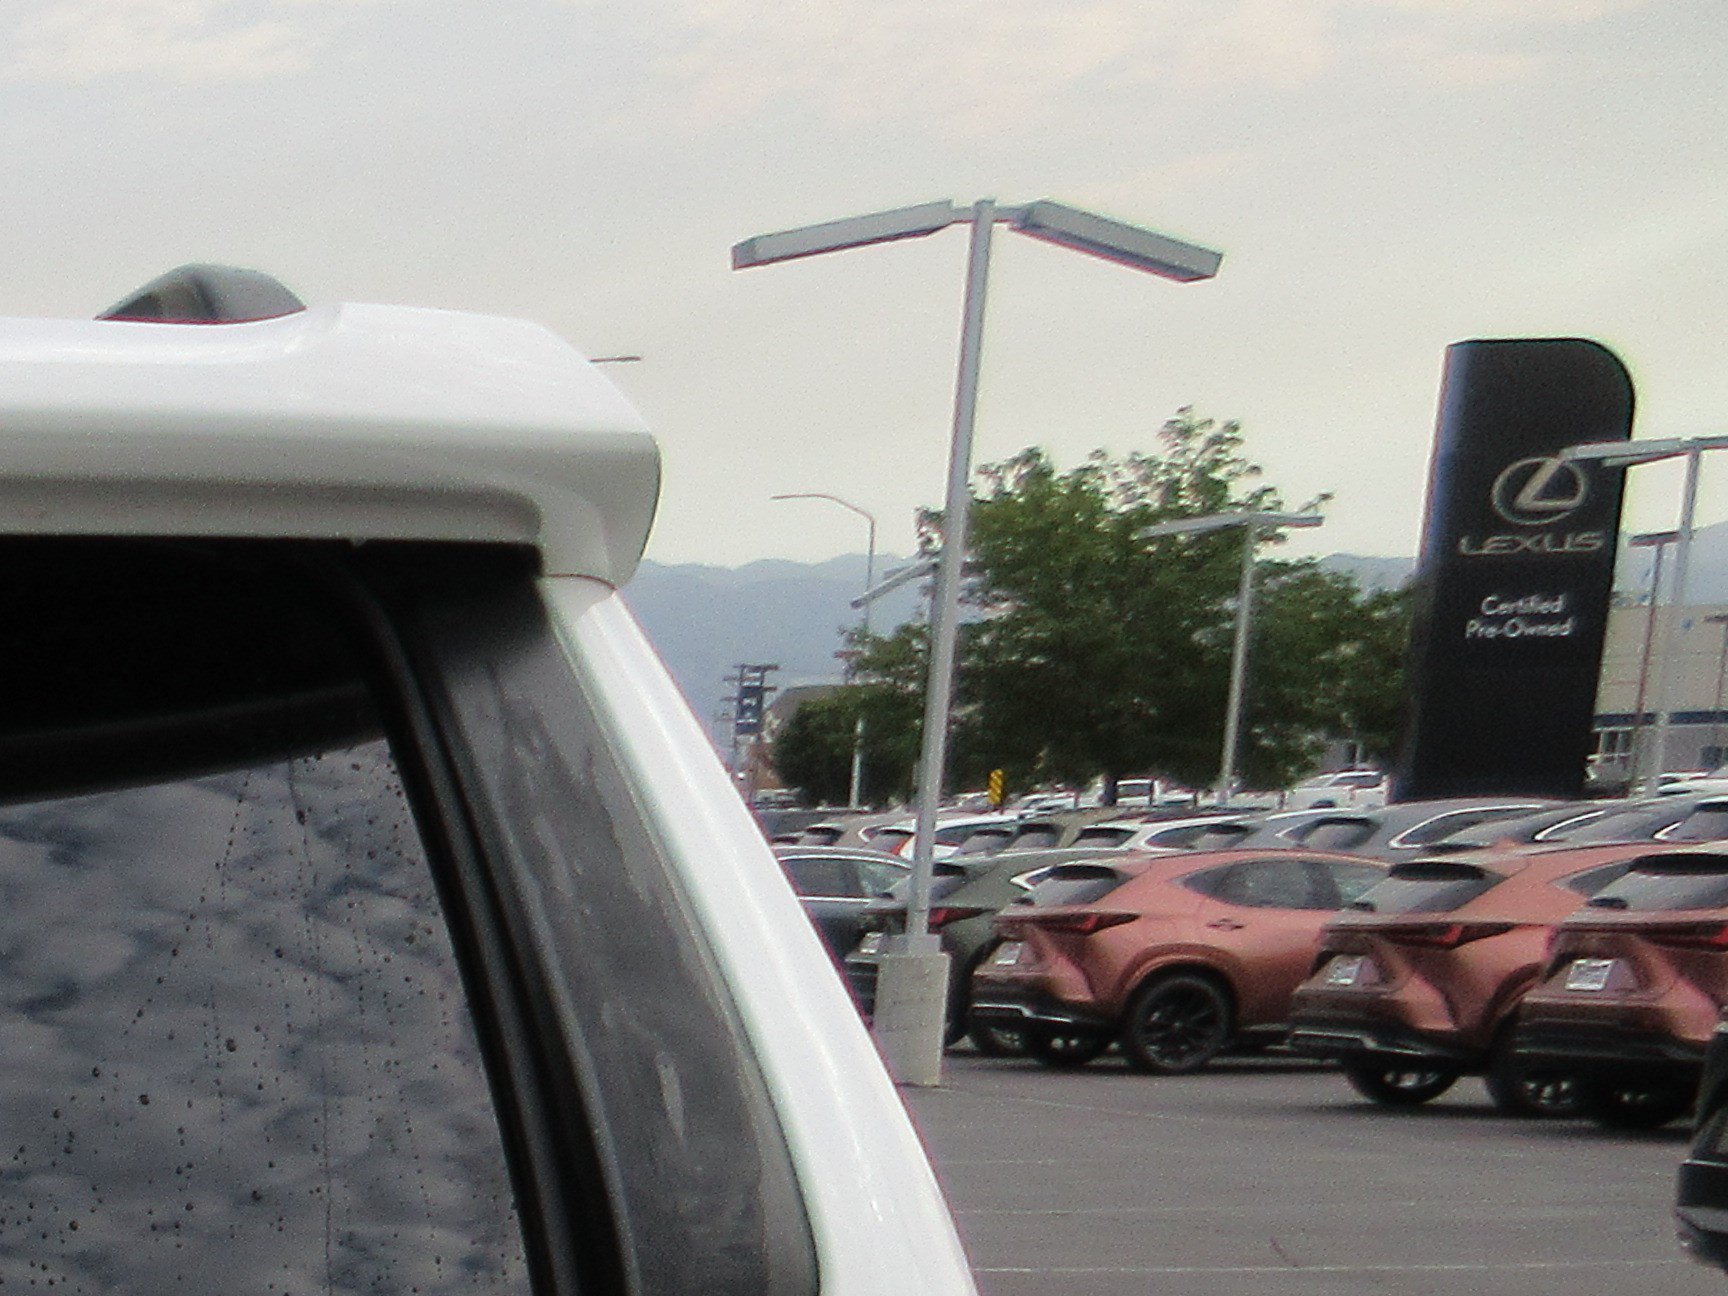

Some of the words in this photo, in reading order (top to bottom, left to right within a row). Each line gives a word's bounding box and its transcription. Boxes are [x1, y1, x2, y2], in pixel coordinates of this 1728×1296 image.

[1458, 530, 1605, 557] LEXUS
[1481, 593, 1566, 616] Certified
[1464, 616, 1575, 640] Pre-Owned
